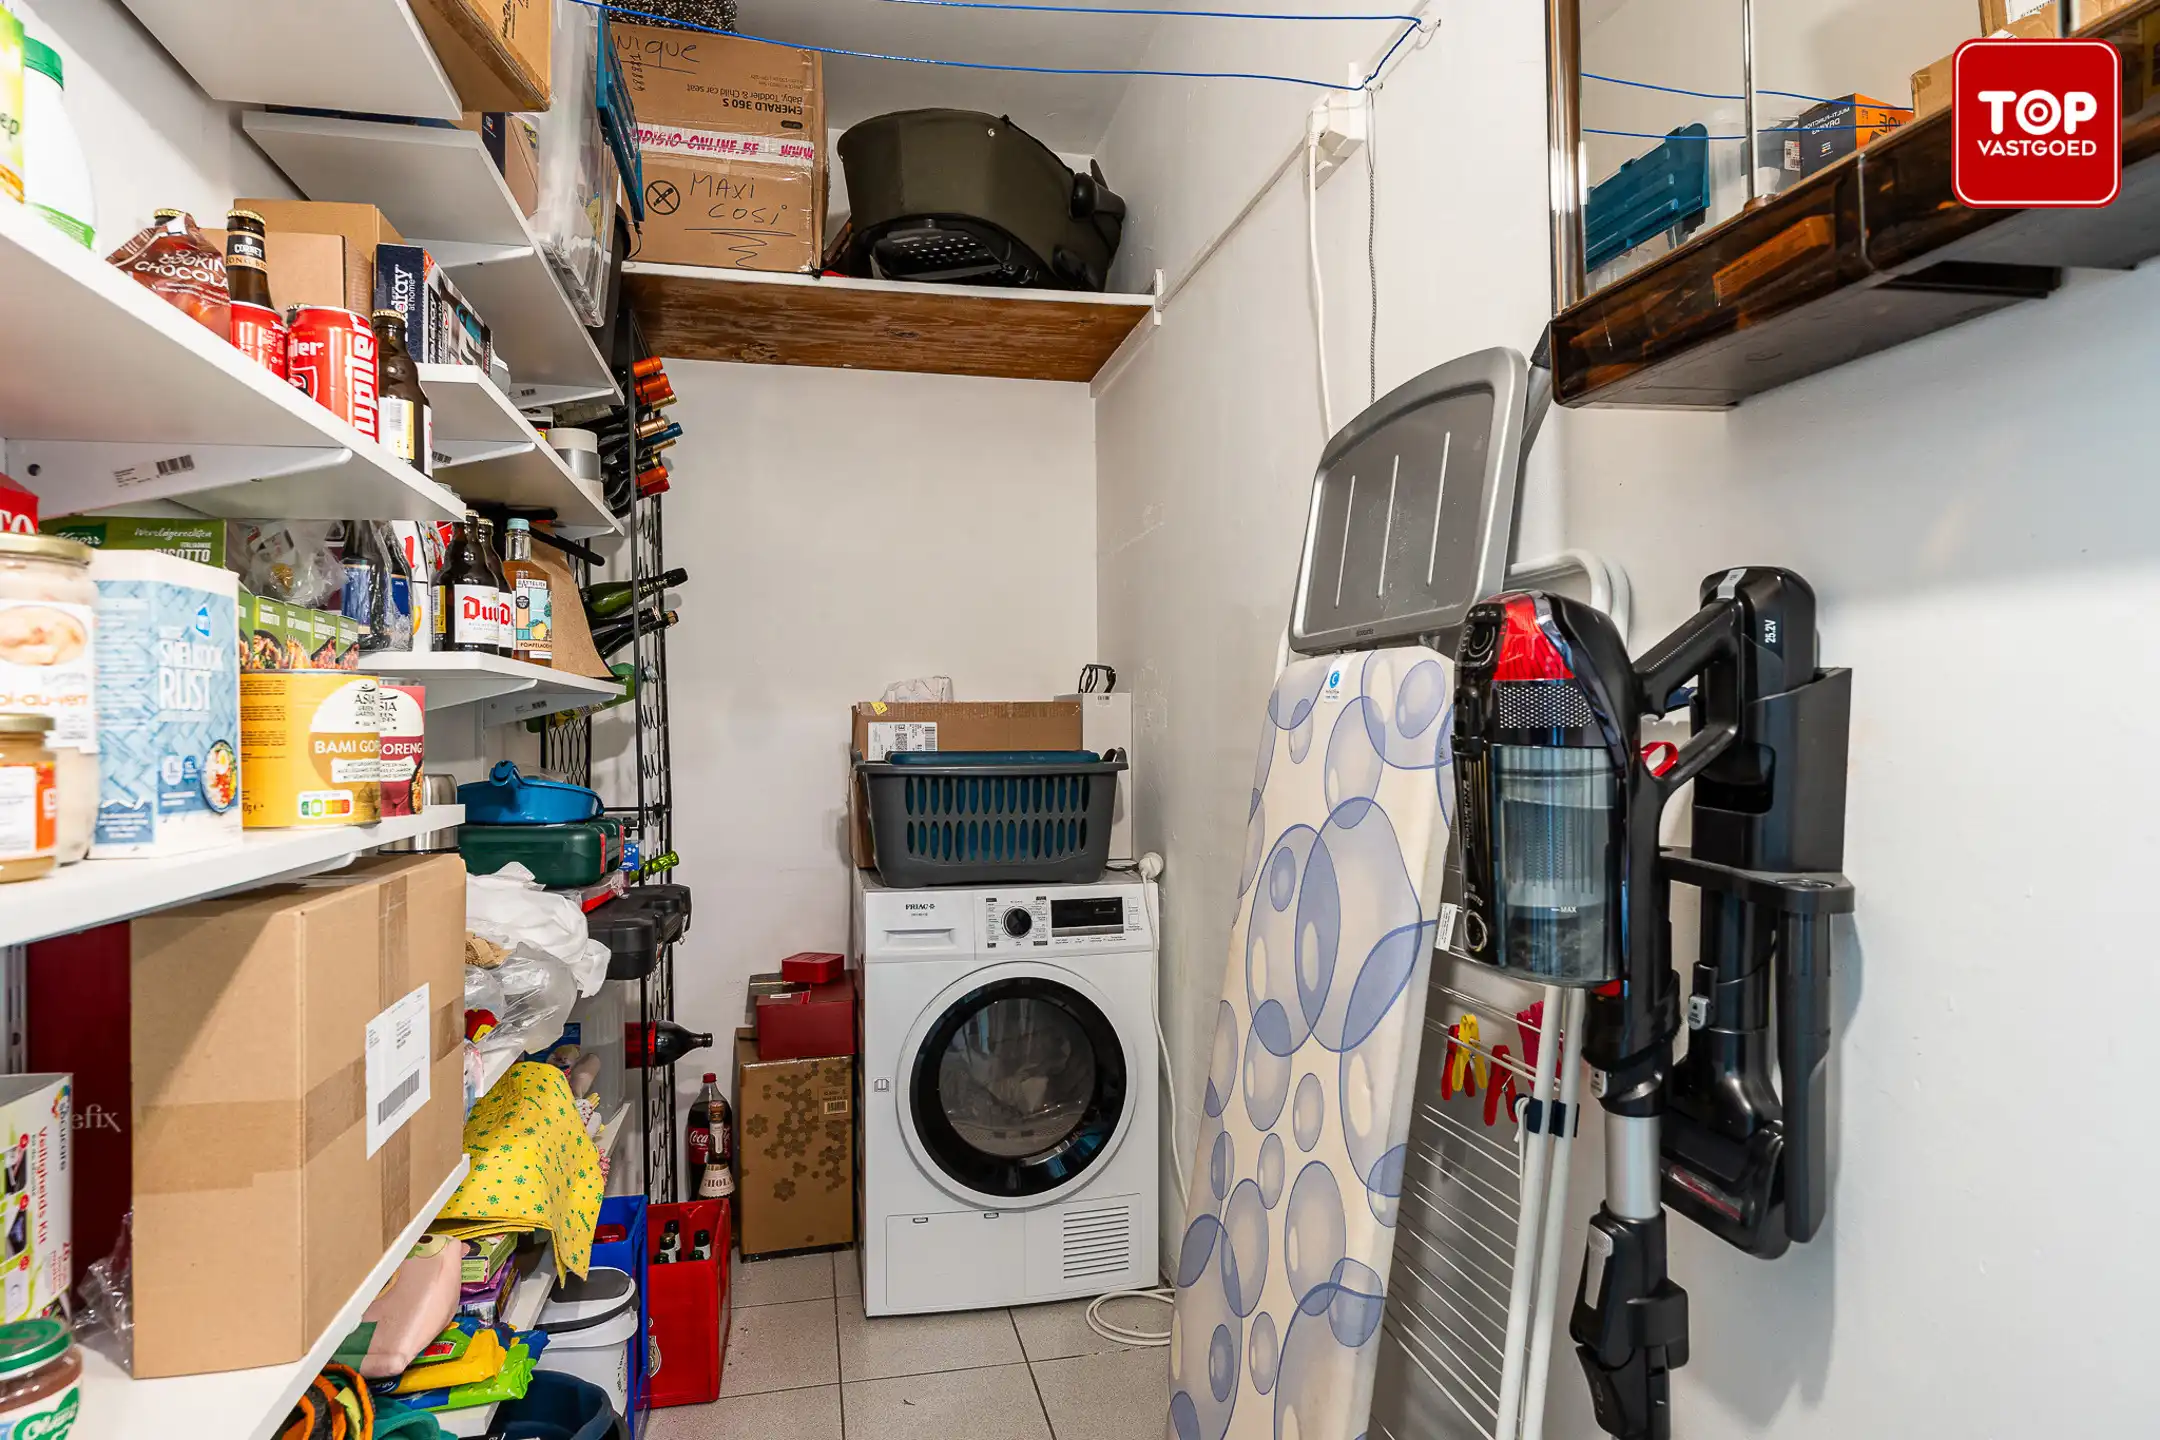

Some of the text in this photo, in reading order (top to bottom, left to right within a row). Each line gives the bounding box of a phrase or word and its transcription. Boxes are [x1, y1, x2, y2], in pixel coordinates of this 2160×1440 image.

[687, 83, 803, 103] Baby, Toddler & Child car seat
[722, 98, 803, 116] EMERALD 360 S
[1765, 619, 1777, 643] 25.2V
[314, 740, 356, 754] BAMI
